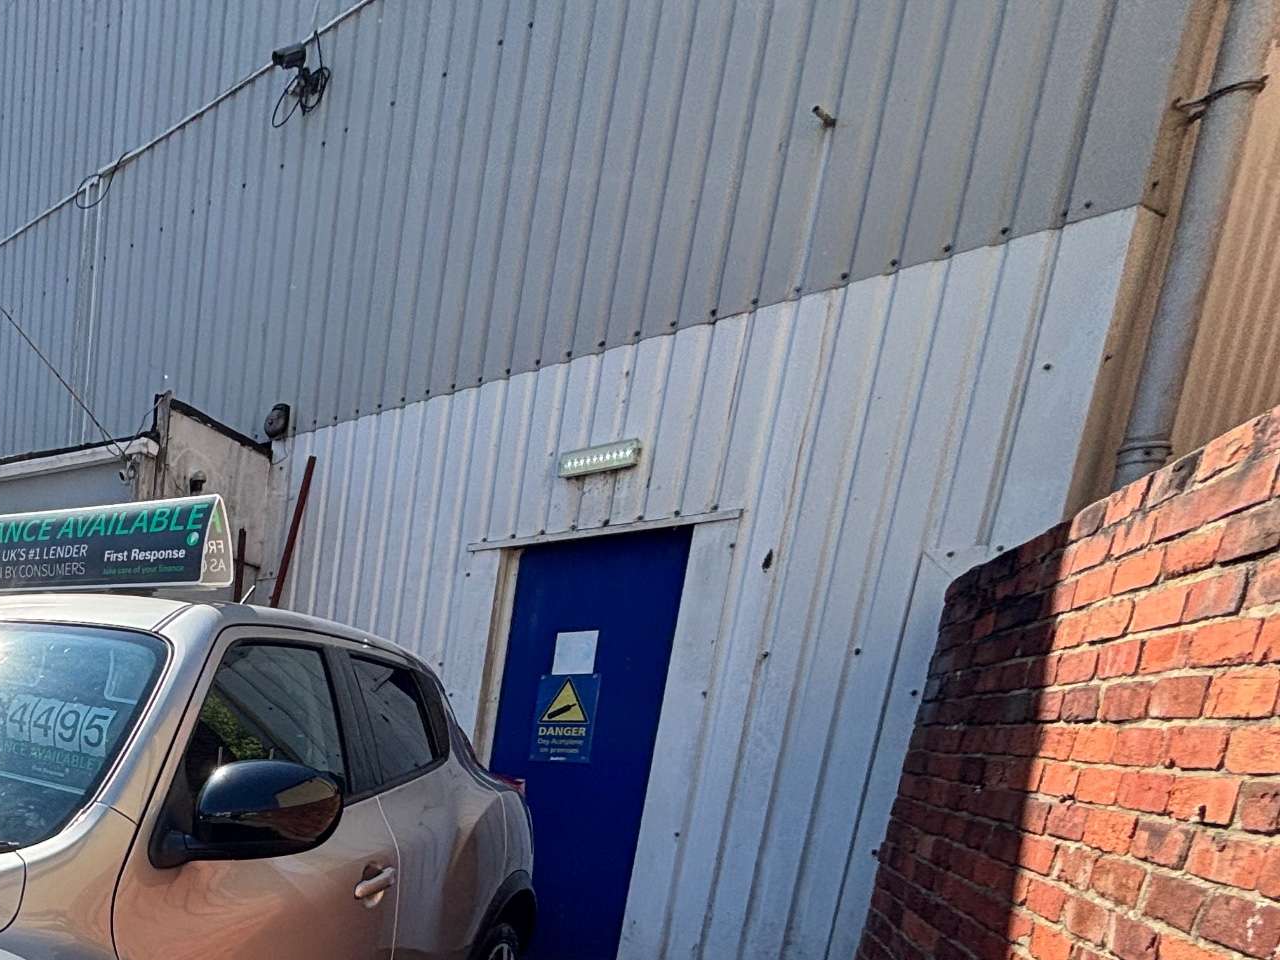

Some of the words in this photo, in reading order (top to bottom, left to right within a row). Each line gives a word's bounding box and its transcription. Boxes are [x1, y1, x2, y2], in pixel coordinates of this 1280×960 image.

[56, 503, 209, 539] AVAILABLE
[28, 547, 40, 560] #1
[43, 544, 89, 559] LENDER
[104, 549, 128, 562] First
[131, 548, 186, 563] Response
[5, 565, 17, 578] BY
[19, 562, 86, 577] CONSUMERS
[538, 726, 586, 737] DANGER
